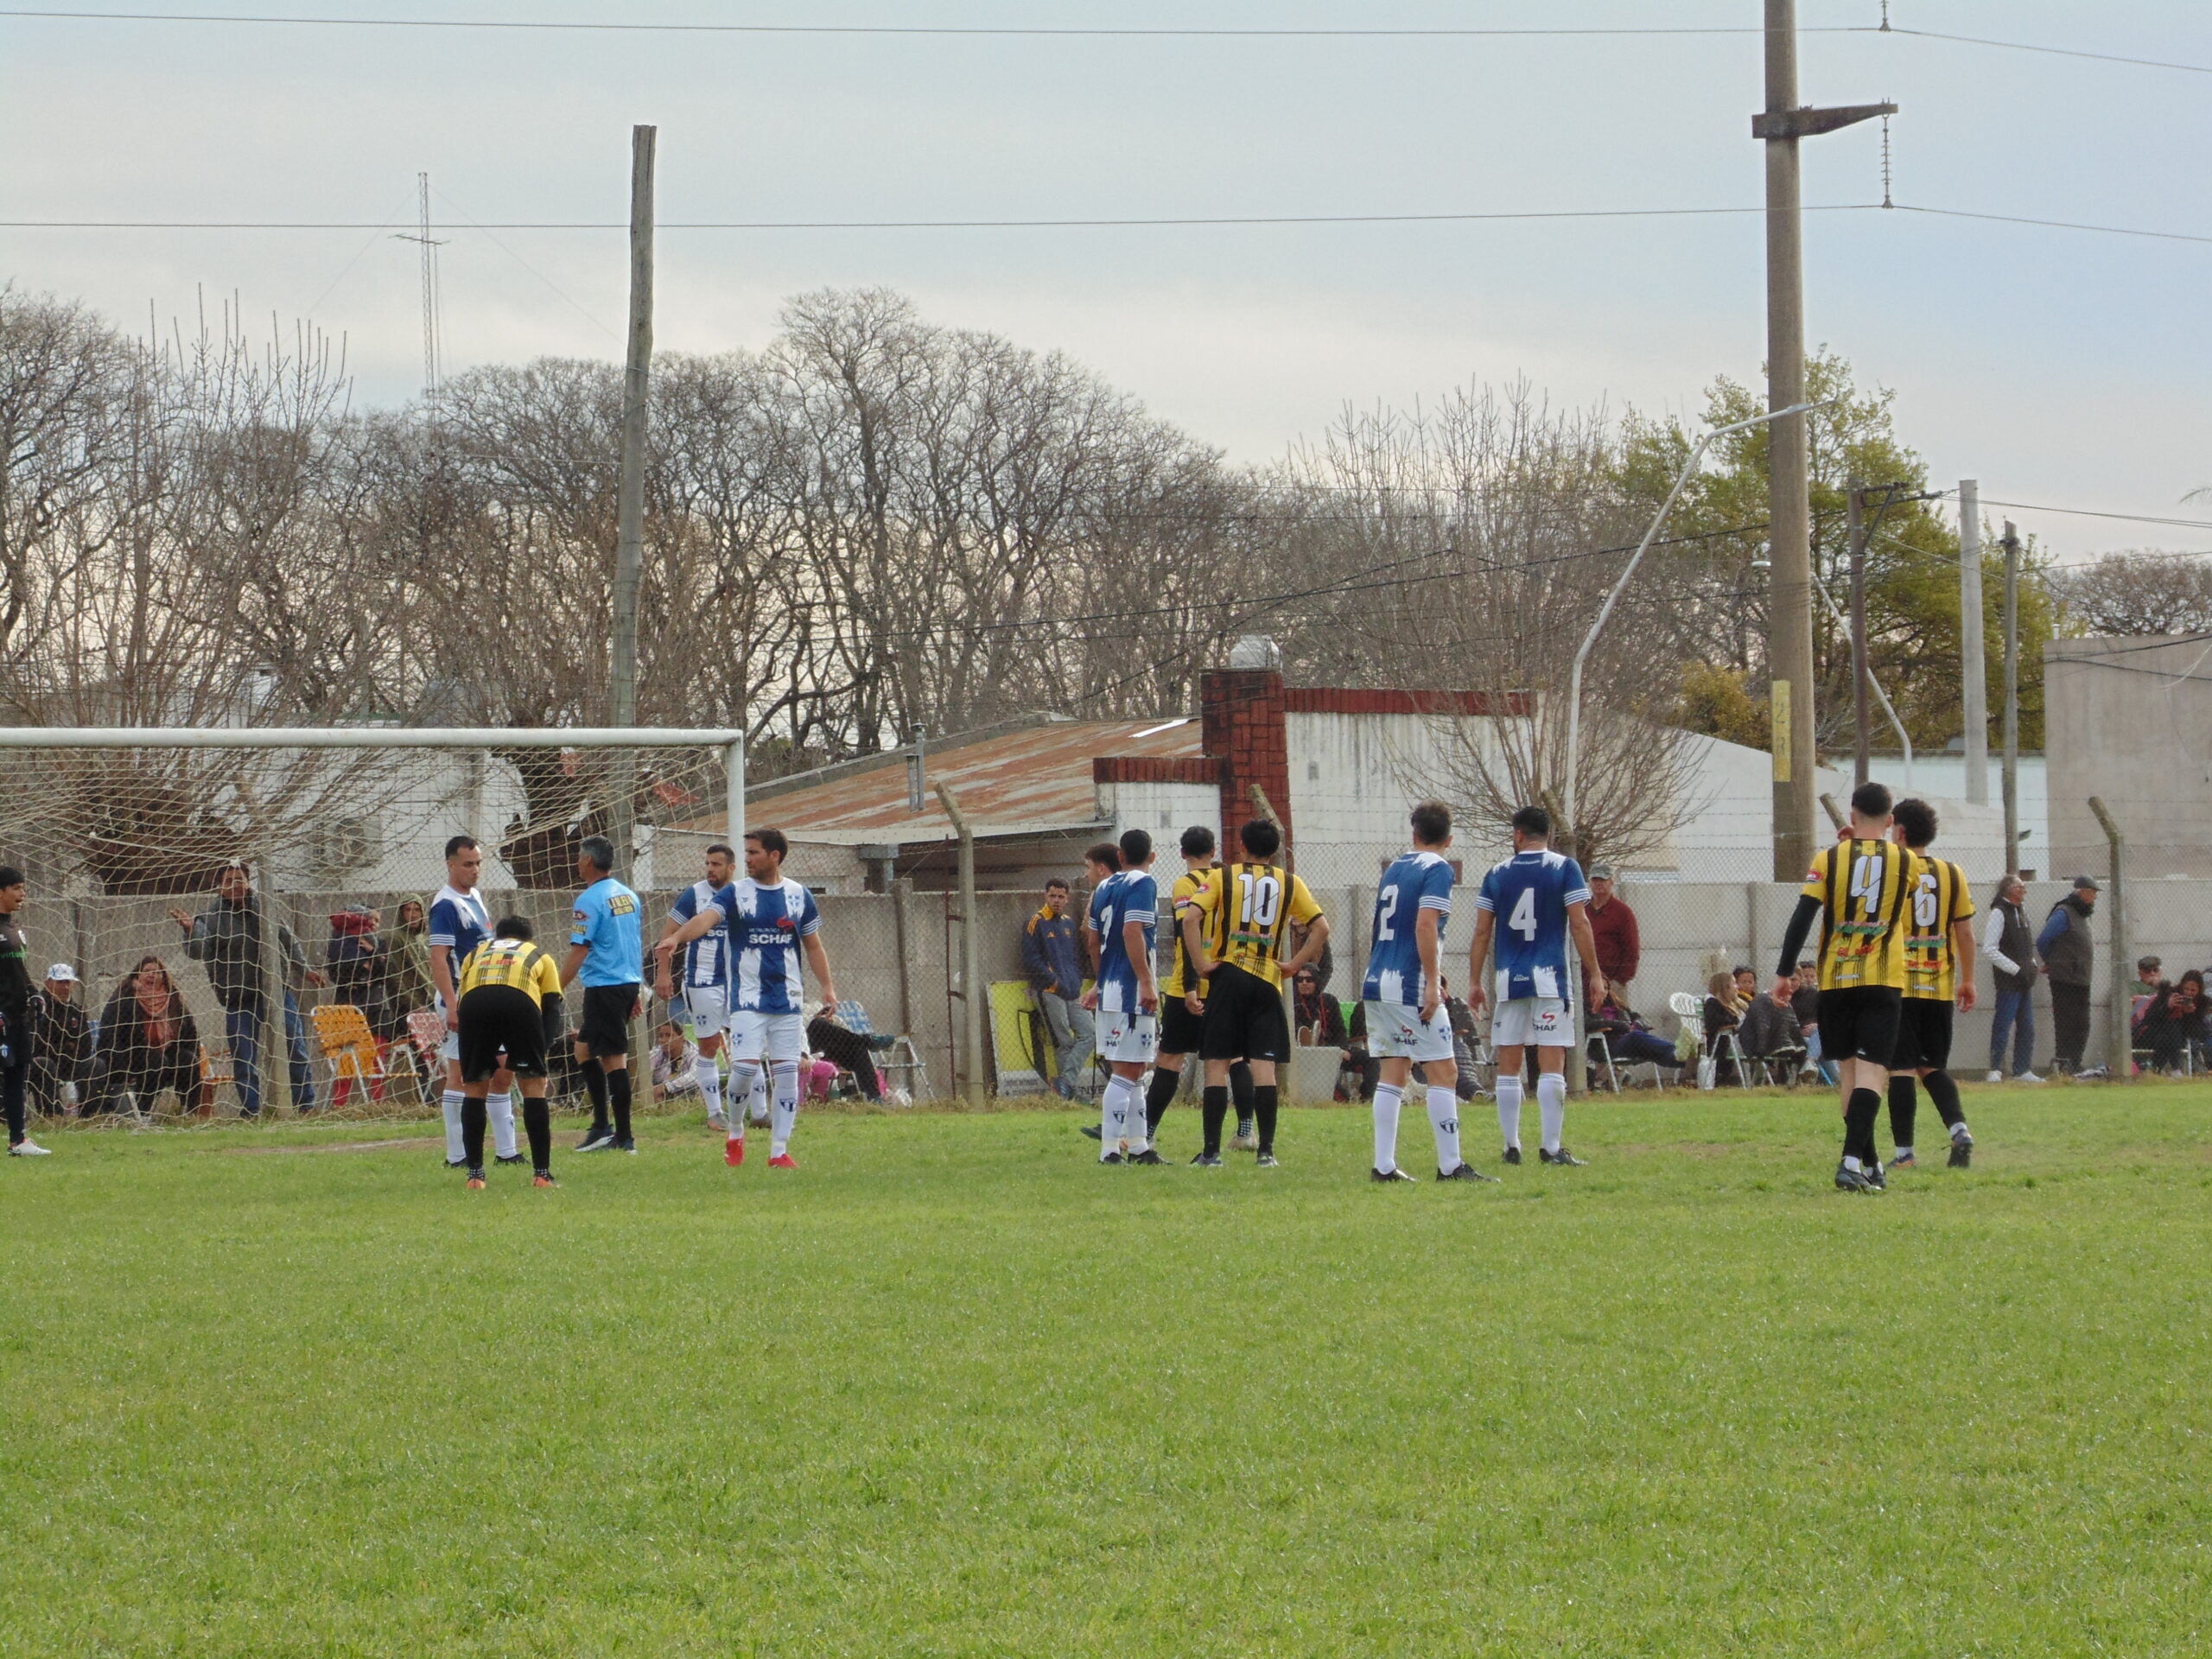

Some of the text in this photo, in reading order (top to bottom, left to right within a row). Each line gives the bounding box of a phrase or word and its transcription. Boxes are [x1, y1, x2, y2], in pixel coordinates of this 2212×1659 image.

[1237, 873, 1279, 925] 10
[1851, 855, 1883, 913] 4
[1915, 874, 1937, 927] 6
[748, 933, 792, 944] SCHAF
[1378, 884, 1399, 941] 2
[1509, 887, 1537, 942] 4
